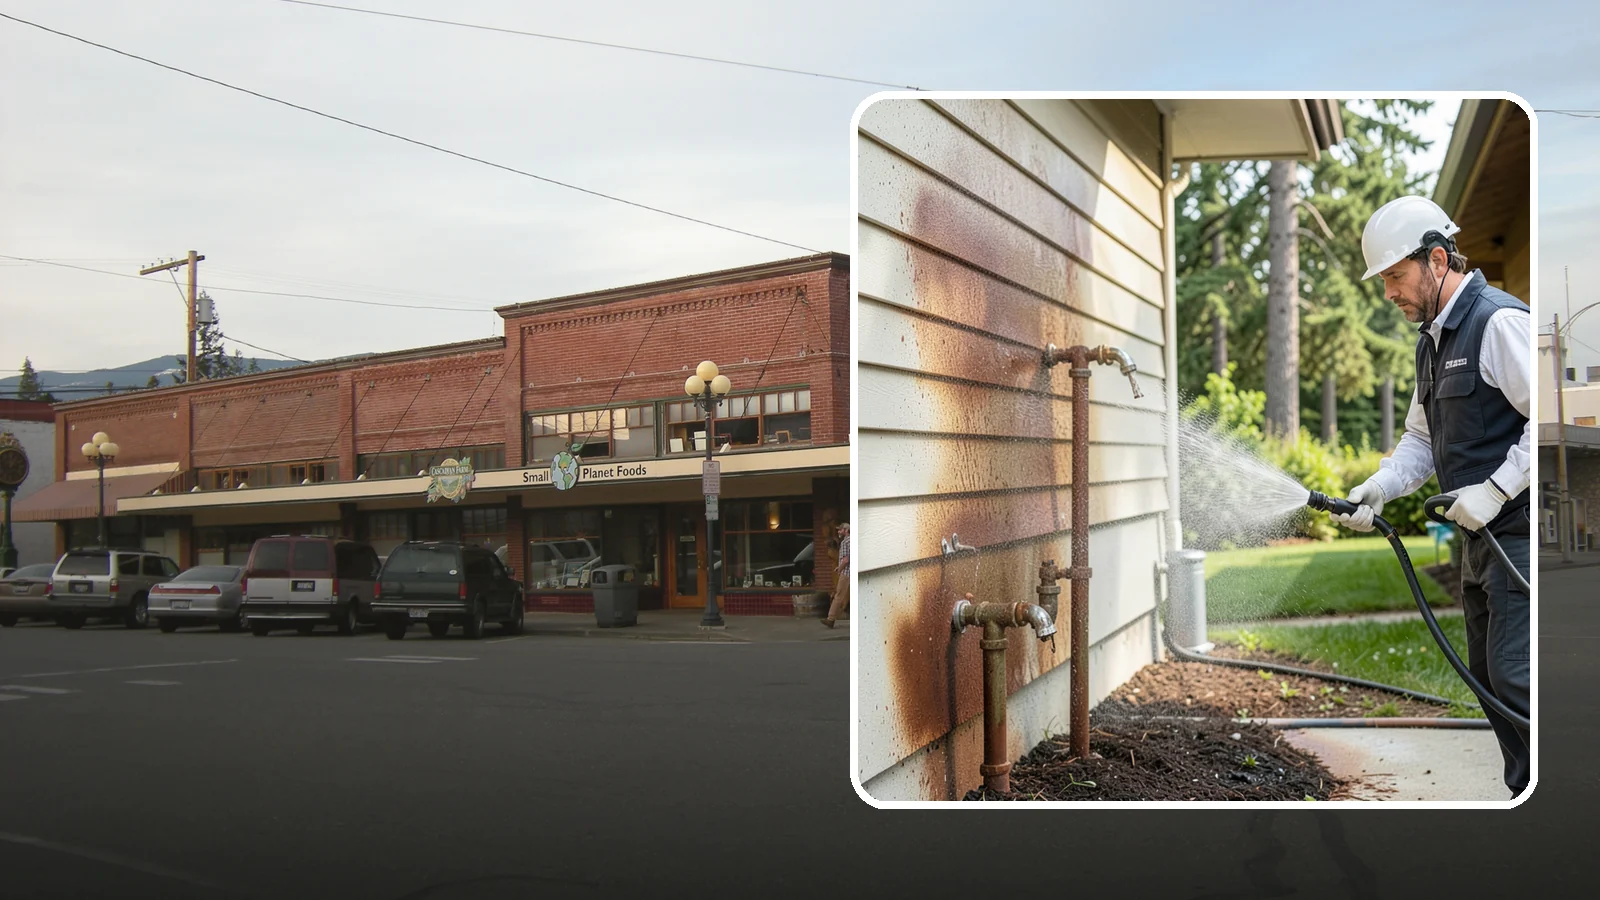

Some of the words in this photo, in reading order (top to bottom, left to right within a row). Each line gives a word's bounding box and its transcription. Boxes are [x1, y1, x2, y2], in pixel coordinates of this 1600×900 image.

[523, 471, 549, 483] Small
[583, 468, 614, 479] Planet
[617, 464, 647, 477] Foods
